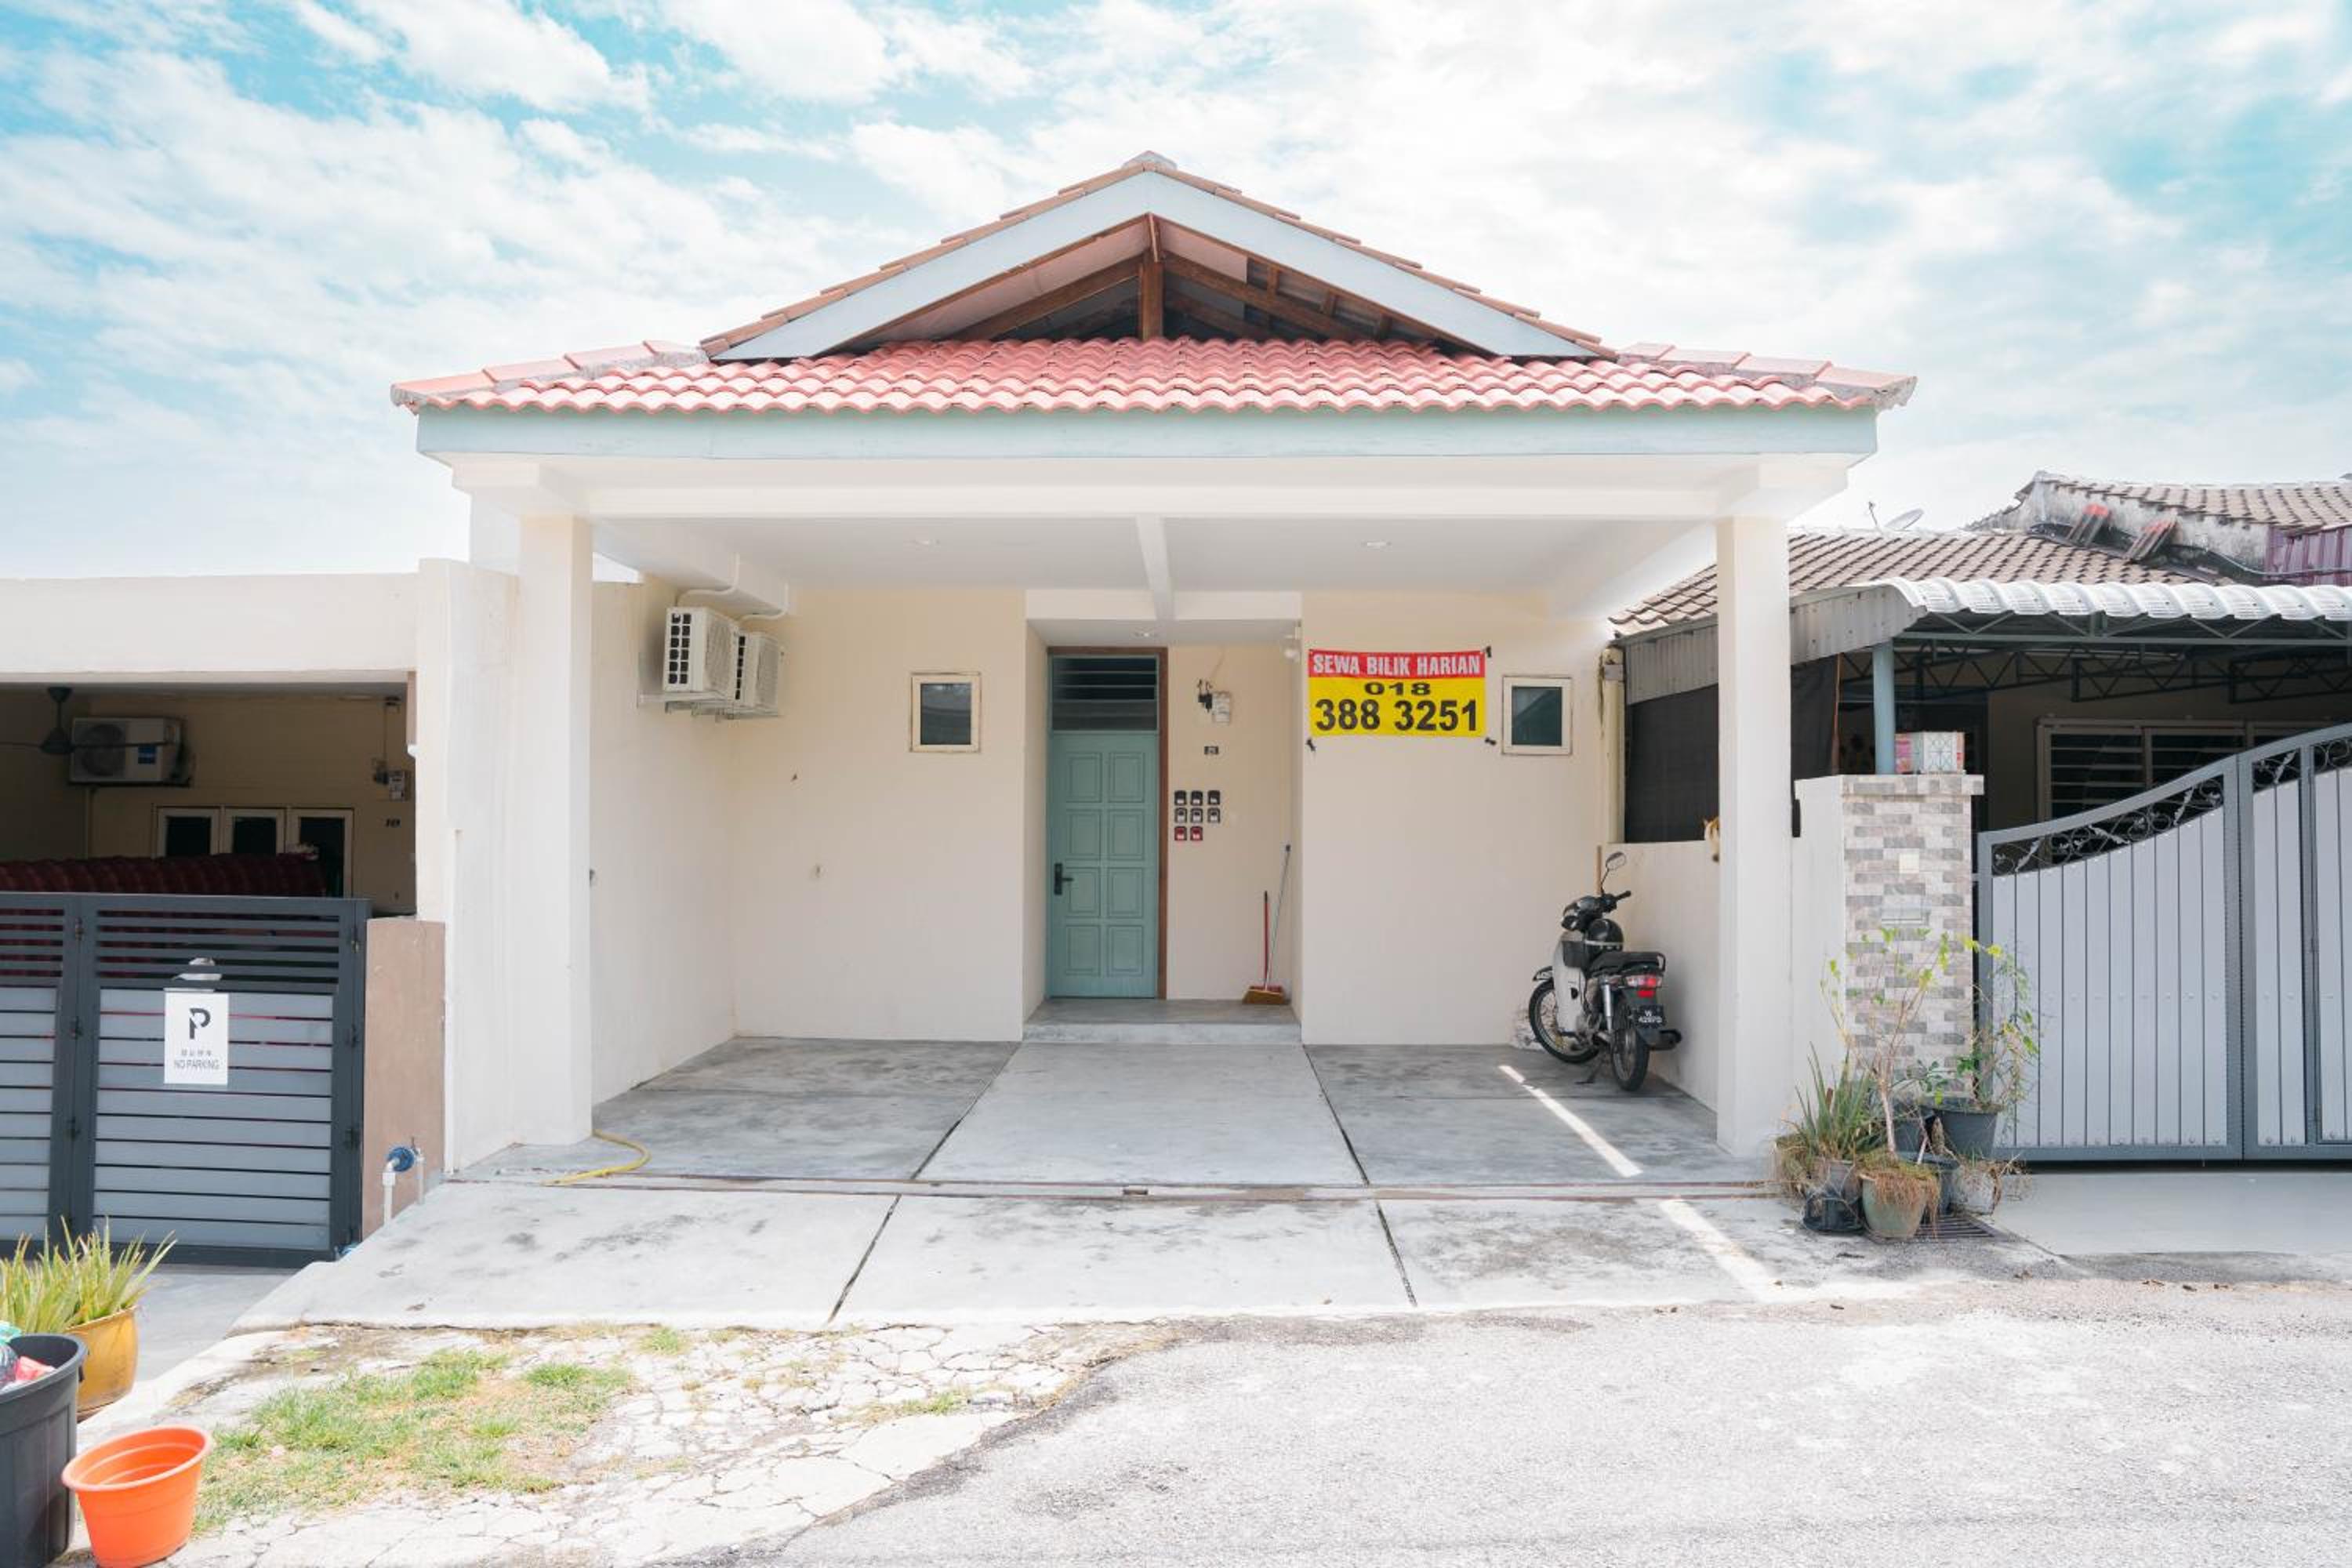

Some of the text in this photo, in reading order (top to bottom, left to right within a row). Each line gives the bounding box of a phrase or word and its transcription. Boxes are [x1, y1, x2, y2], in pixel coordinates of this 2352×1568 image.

[1312, 655, 1480, 676] SEWA BILIK HARIAN
[1364, 682, 1431, 695] 018
[1315, 699, 1476, 731] 388 3251
[189, 1007, 211, 1040] P
[174, 1059, 220, 1070] NO PARKING
